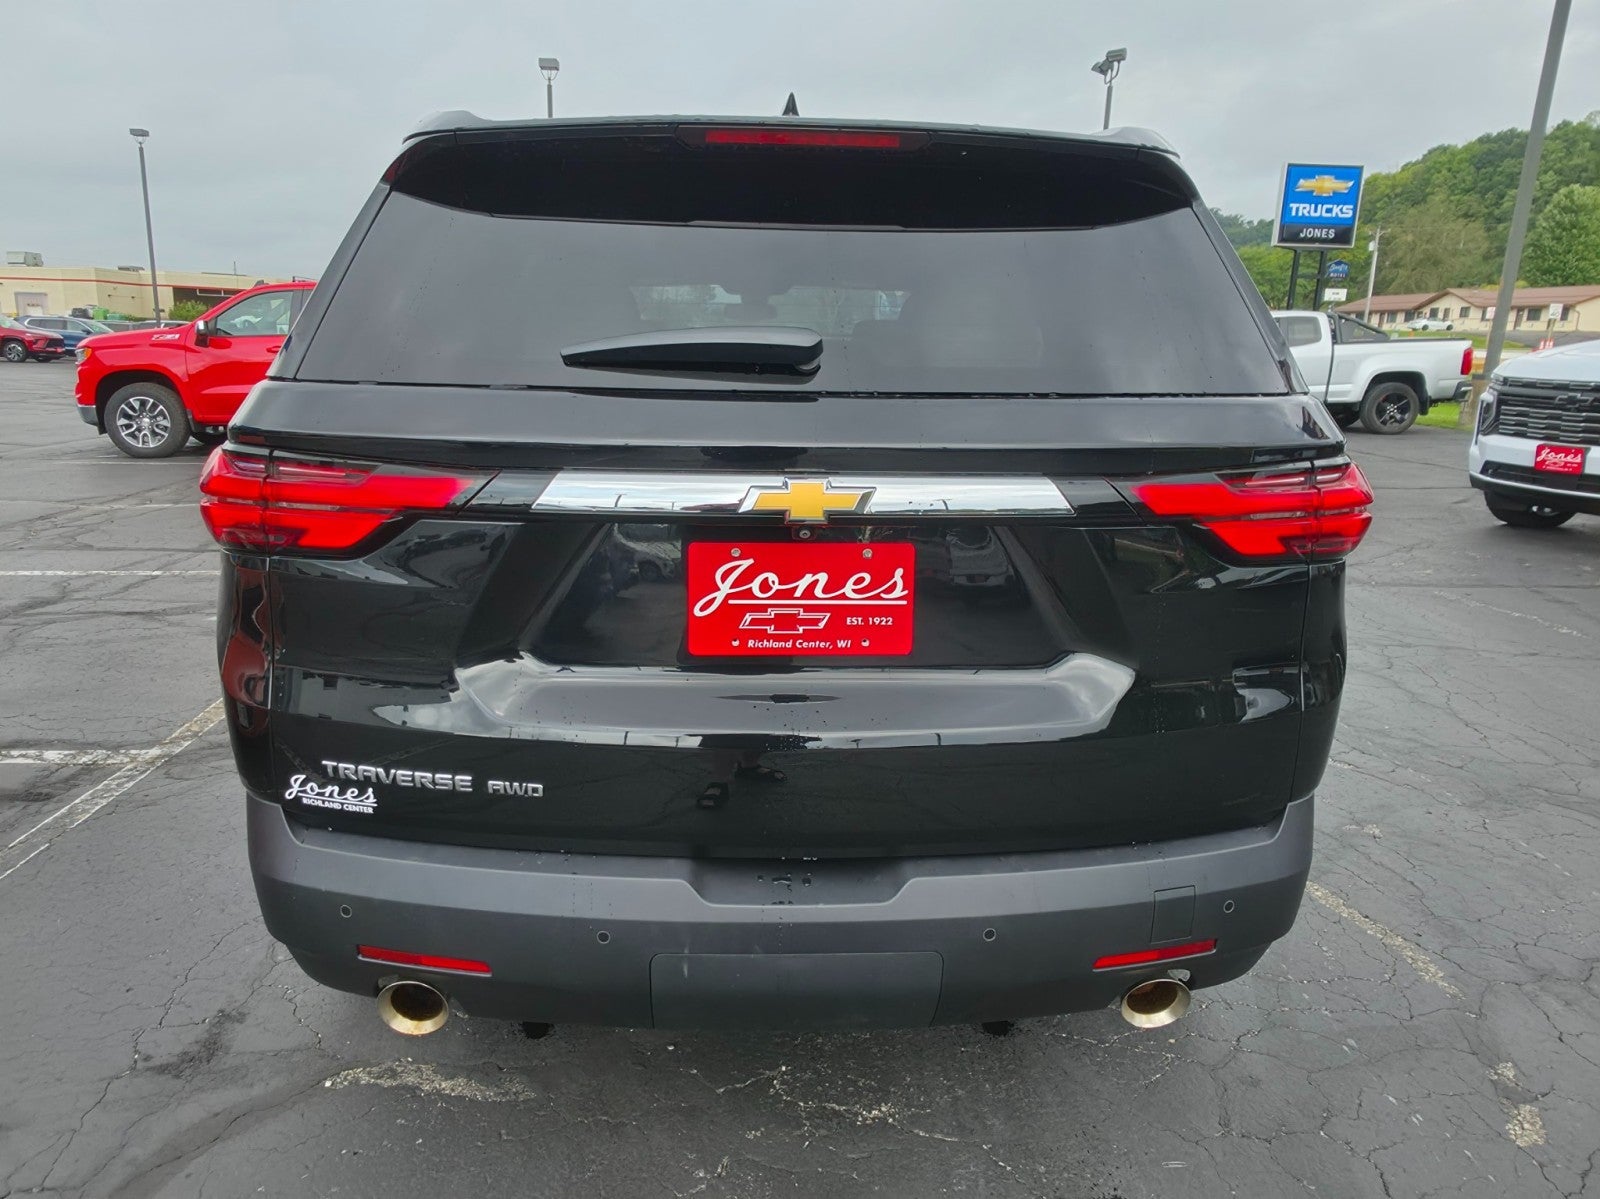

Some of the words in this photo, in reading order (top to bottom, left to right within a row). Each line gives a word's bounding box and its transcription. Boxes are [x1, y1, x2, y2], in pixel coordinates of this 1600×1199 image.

[1289, 203, 1353, 218] TRUCKS
[1300, 228, 1335, 238] JONES
[1536, 448, 1581, 462] Jones
[693, 558, 908, 617] Jones
[846, 617, 864, 625] EST.
[868, 617, 893, 626] 1922
[747, 639, 792, 648] Richland
[796, 640, 833, 649] Center,
[837, 640, 851, 648] WI
[321, 760, 473, 792] TRAVERSE
[487, 780, 544, 797] AWD
[285, 774, 378, 804] Jones
[302, 797, 342, 810] RICHLAND
[343, 803, 374, 814] CENTER
